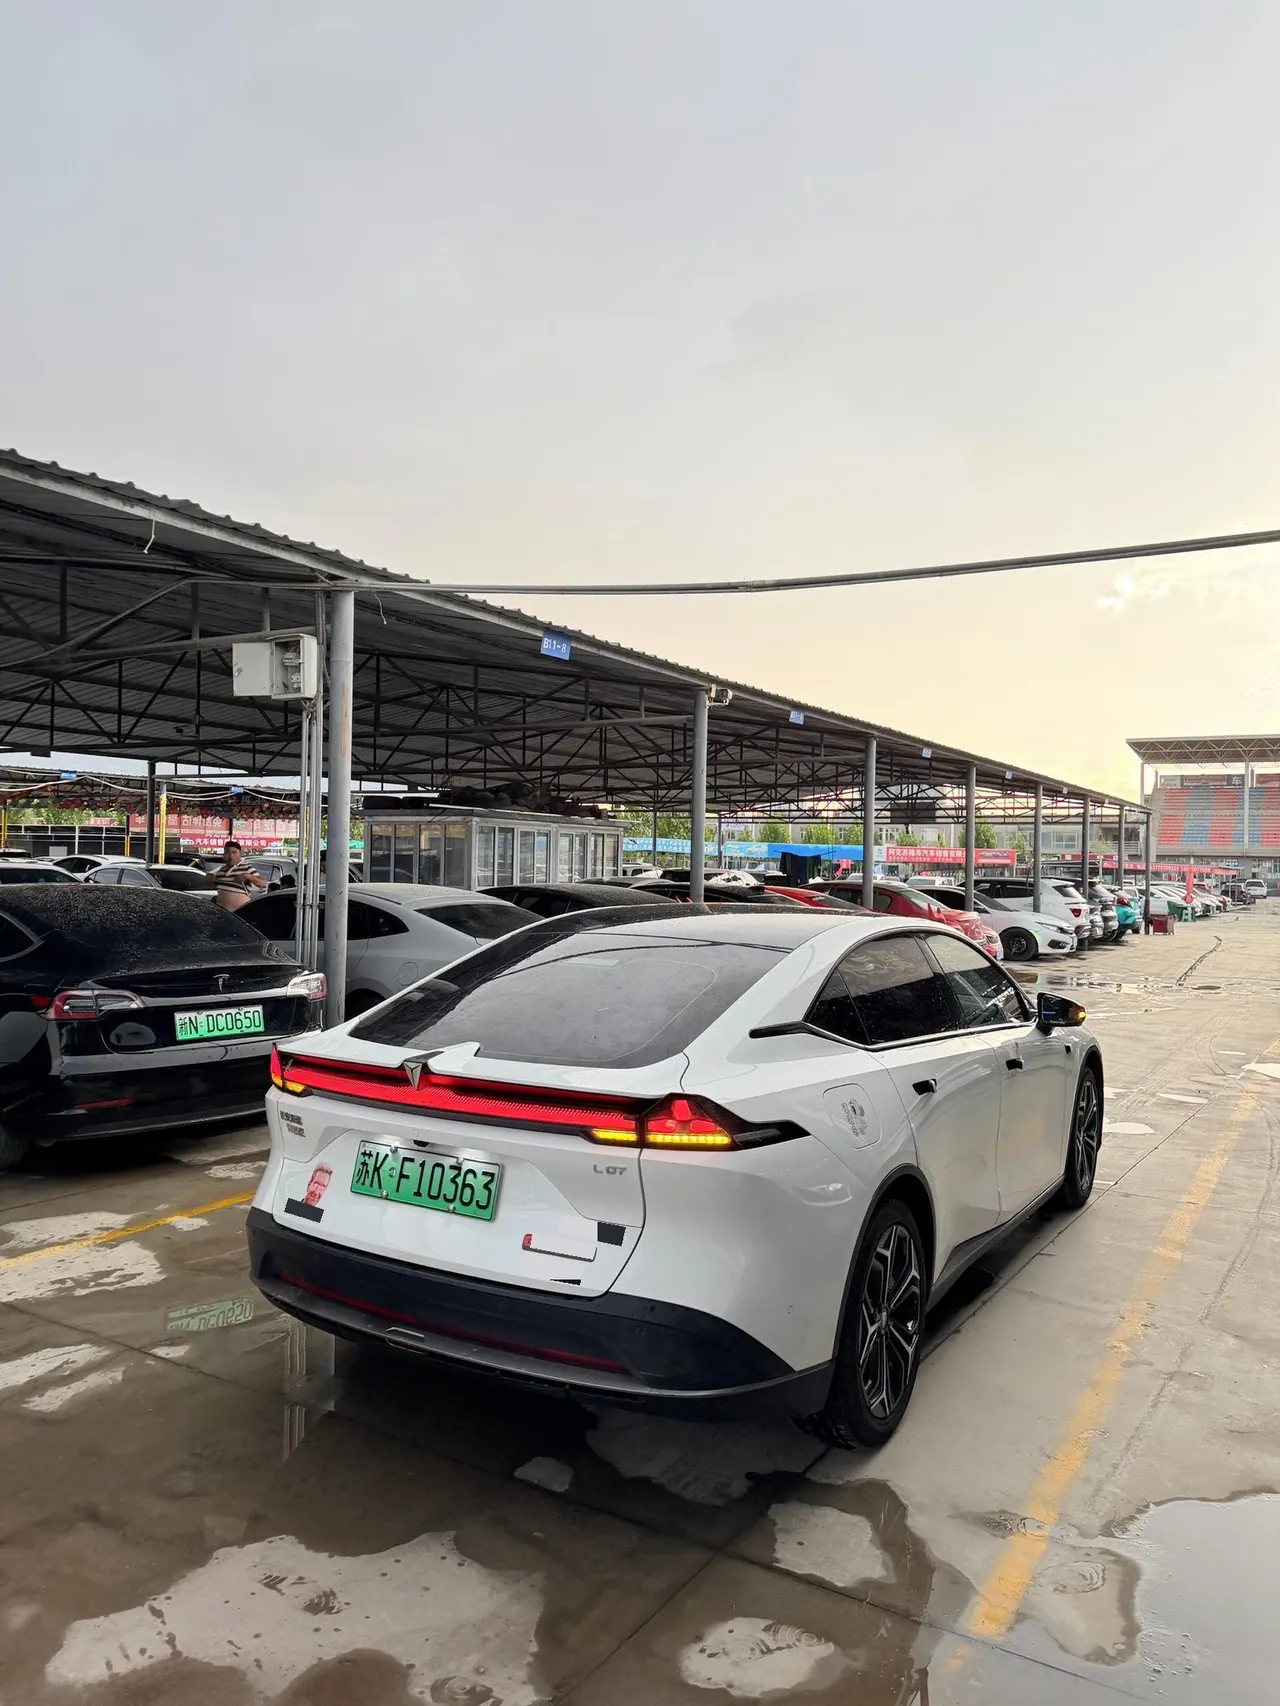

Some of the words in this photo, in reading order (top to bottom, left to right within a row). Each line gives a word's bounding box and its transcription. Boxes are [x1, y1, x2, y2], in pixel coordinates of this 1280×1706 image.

[543, 637, 567, 653] B11-8
[195, 838, 267, 848] 汽车销售有限公司
